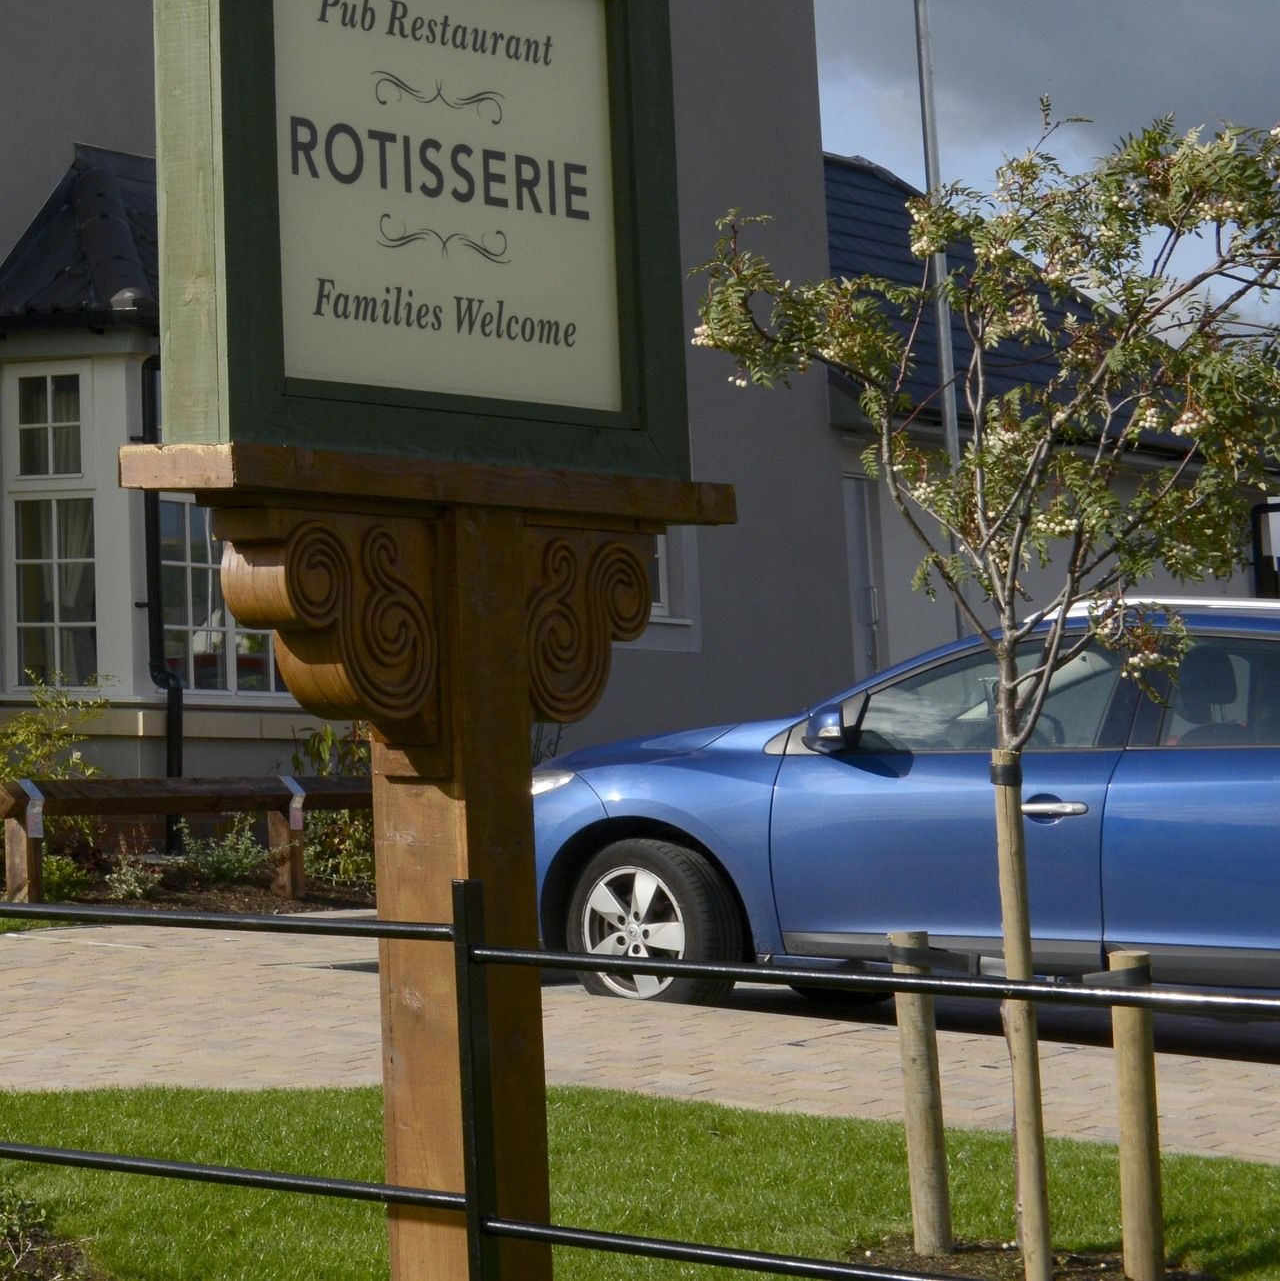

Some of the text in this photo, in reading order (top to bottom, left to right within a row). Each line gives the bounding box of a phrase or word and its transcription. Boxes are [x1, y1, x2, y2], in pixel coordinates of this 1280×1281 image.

[386, 0, 553, 66] Restaurant
[290, 115, 590, 220] ROTISSERIE
[313, 277, 576, 348] Families Welcome
